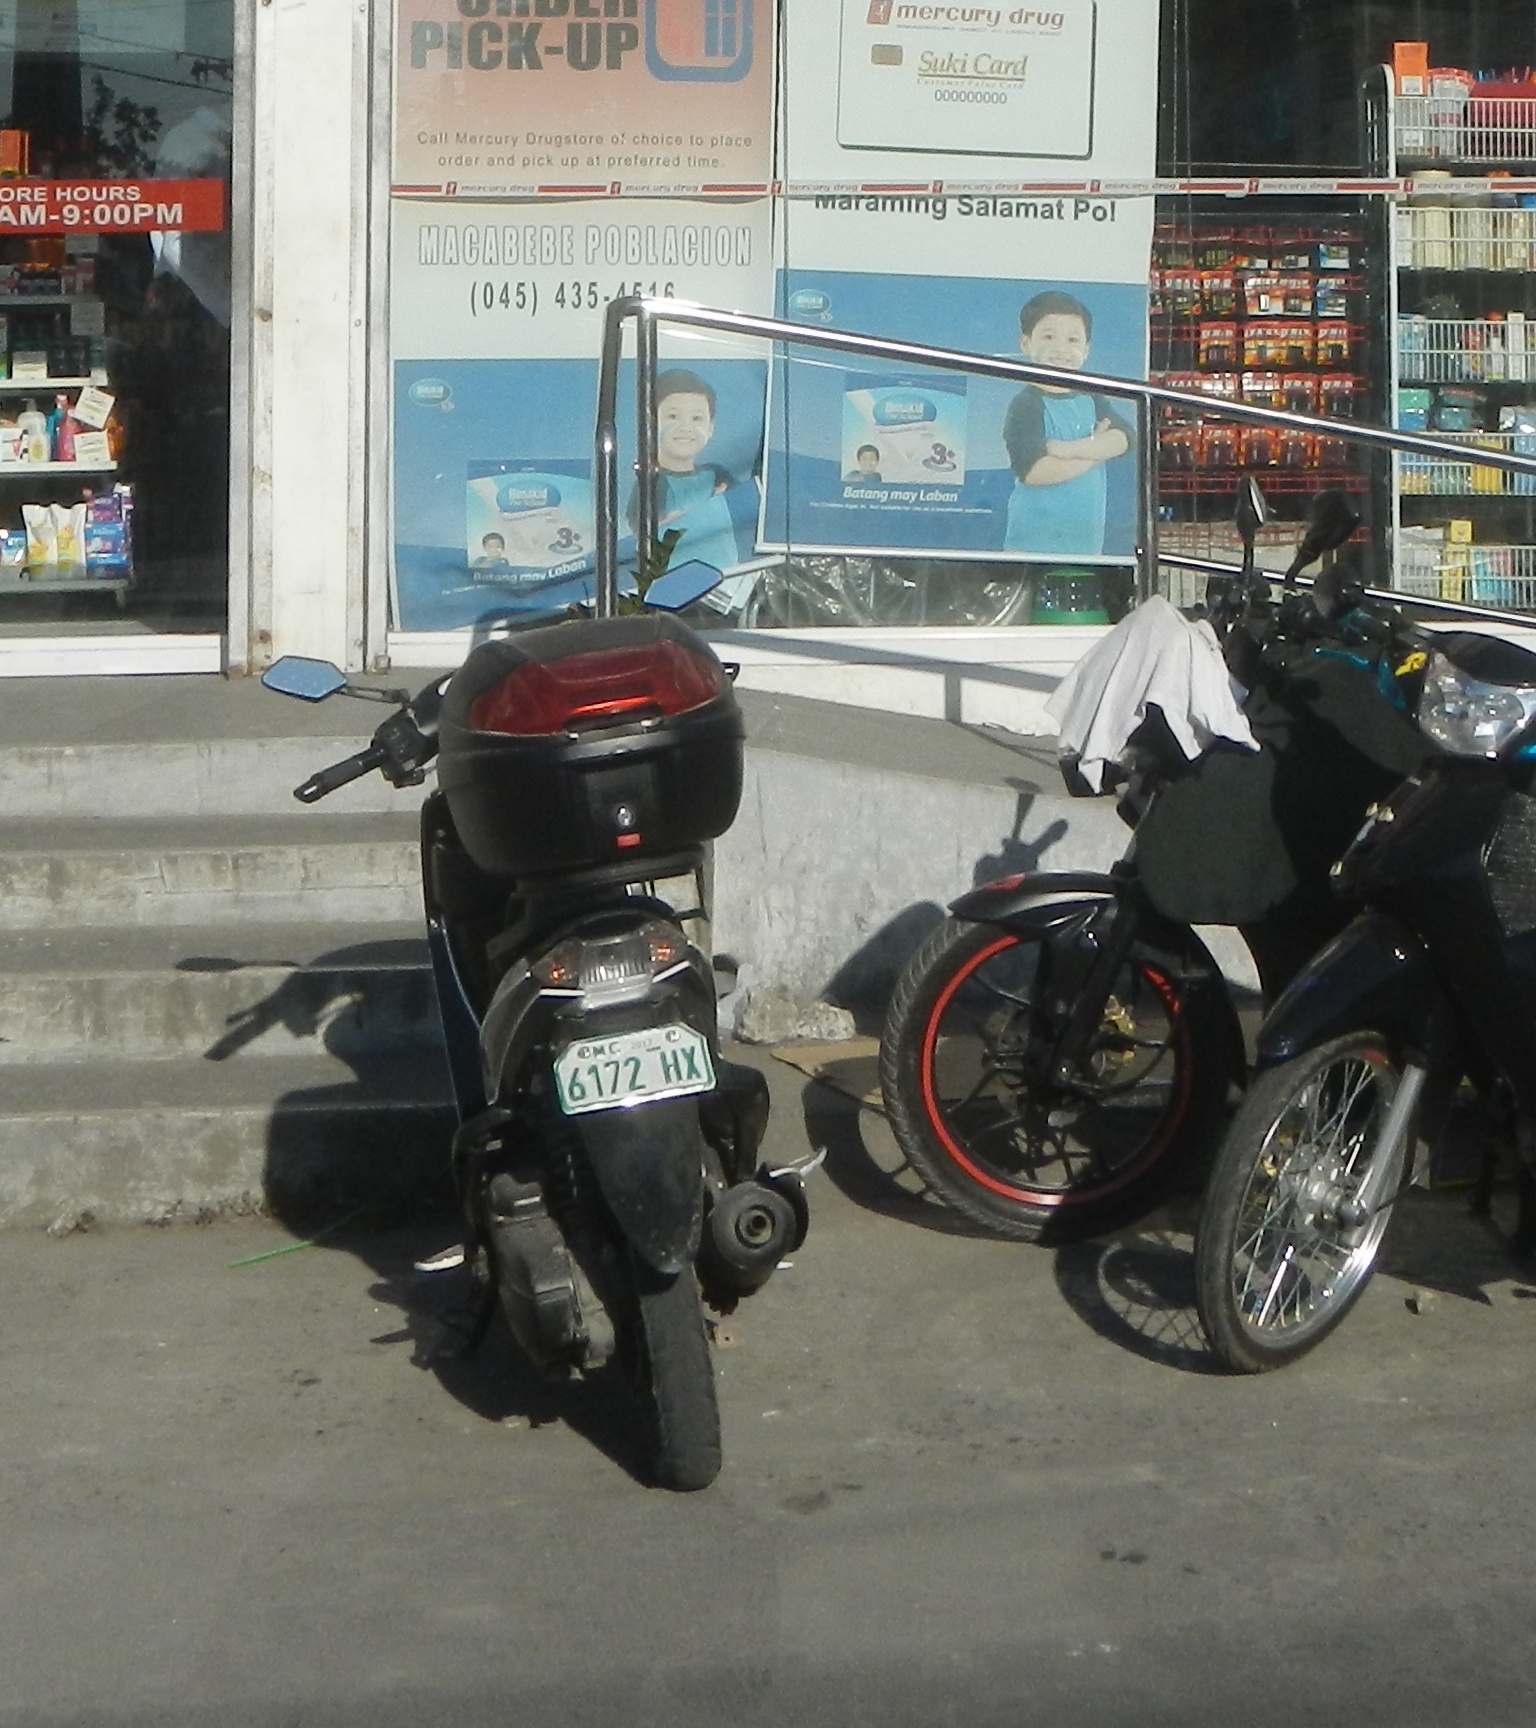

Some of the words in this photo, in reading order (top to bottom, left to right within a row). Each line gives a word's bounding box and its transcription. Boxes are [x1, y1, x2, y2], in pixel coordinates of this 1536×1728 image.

[897, 4, 1001, 27] mercury
[1009, 8, 1065, 30] drug
[411, 21, 639, 71] PICK-UP
[918, 49, 968, 73] Suki
[973, 53, 1028, 77] Card
[417, 131, 448, 146] Call
[456, 131, 518, 148] Mercury
[526, 132, 604, 149] Drugstore
[632, 133, 683, 147] choice
[689, 134, 704, 147] to
[710, 133, 753, 149] place
[438, 154, 480, 167] order
[487, 154, 515, 167] and
[522, 154, 553, 169] pick
[561, 156, 579, 169] up
[586, 155, 601, 167] at
[607, 154, 681, 169] preferred
[56, 185, 141, 202] HOURS
[815, 194, 947, 221] Maraming
[957, 195, 1064, 221] Salamat
[1074, 199, 1116, 223] Po!
[419, 225, 574, 265] MACABEBE
[585, 225, 751, 266] POBLACION
[470, 281, 538, 315] (045)
[843, 486, 888, 503] Batang
[890, 491, 917, 503] may
[919, 488, 958, 503] Laban
[548, 558, 586, 579] Laban
[567, 1055, 647, 1102] 6172
[659, 1045, 702, 1085] HX
